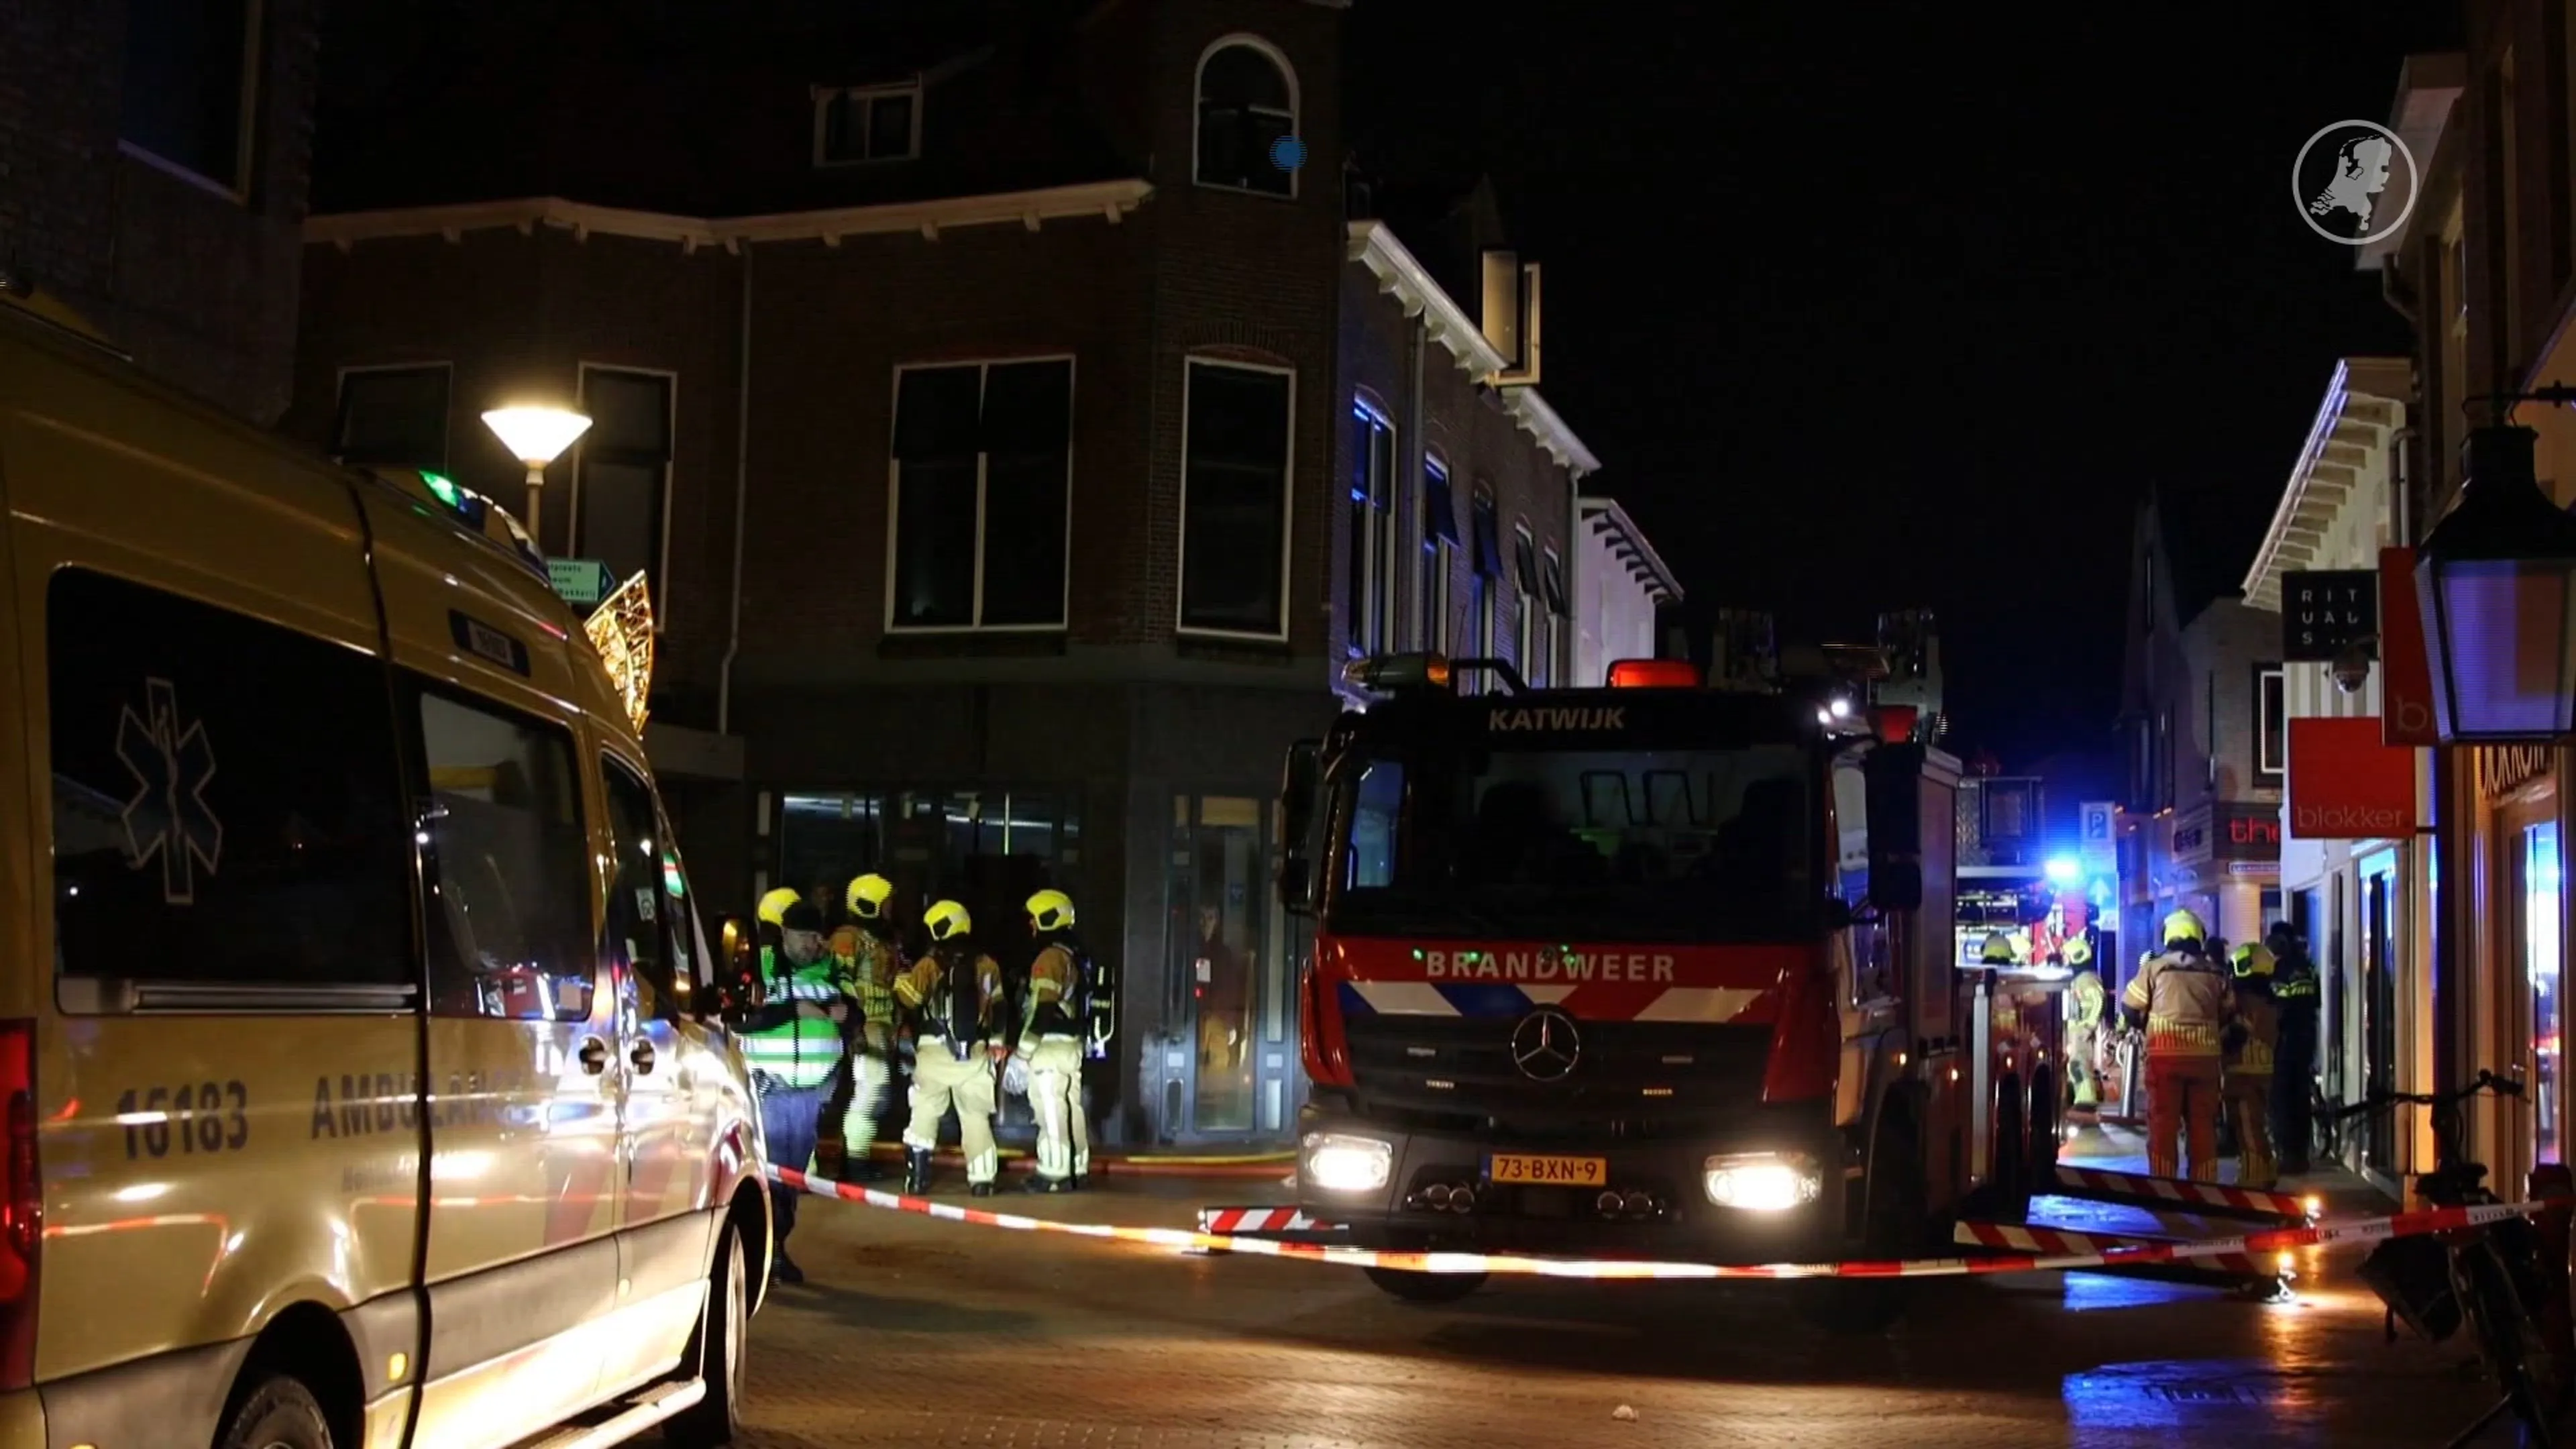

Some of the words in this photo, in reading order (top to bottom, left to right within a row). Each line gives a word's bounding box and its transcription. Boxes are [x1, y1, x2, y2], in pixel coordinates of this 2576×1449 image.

[1489, 706, 1625, 731] KATWIJK
[2298, 805, 2403, 829] blokker
[1426, 950, 1674, 981] BRANDWEER
[117, 1079, 248, 1160] 16183
[1499, 1159, 1597, 1181] 73-BXN-9
